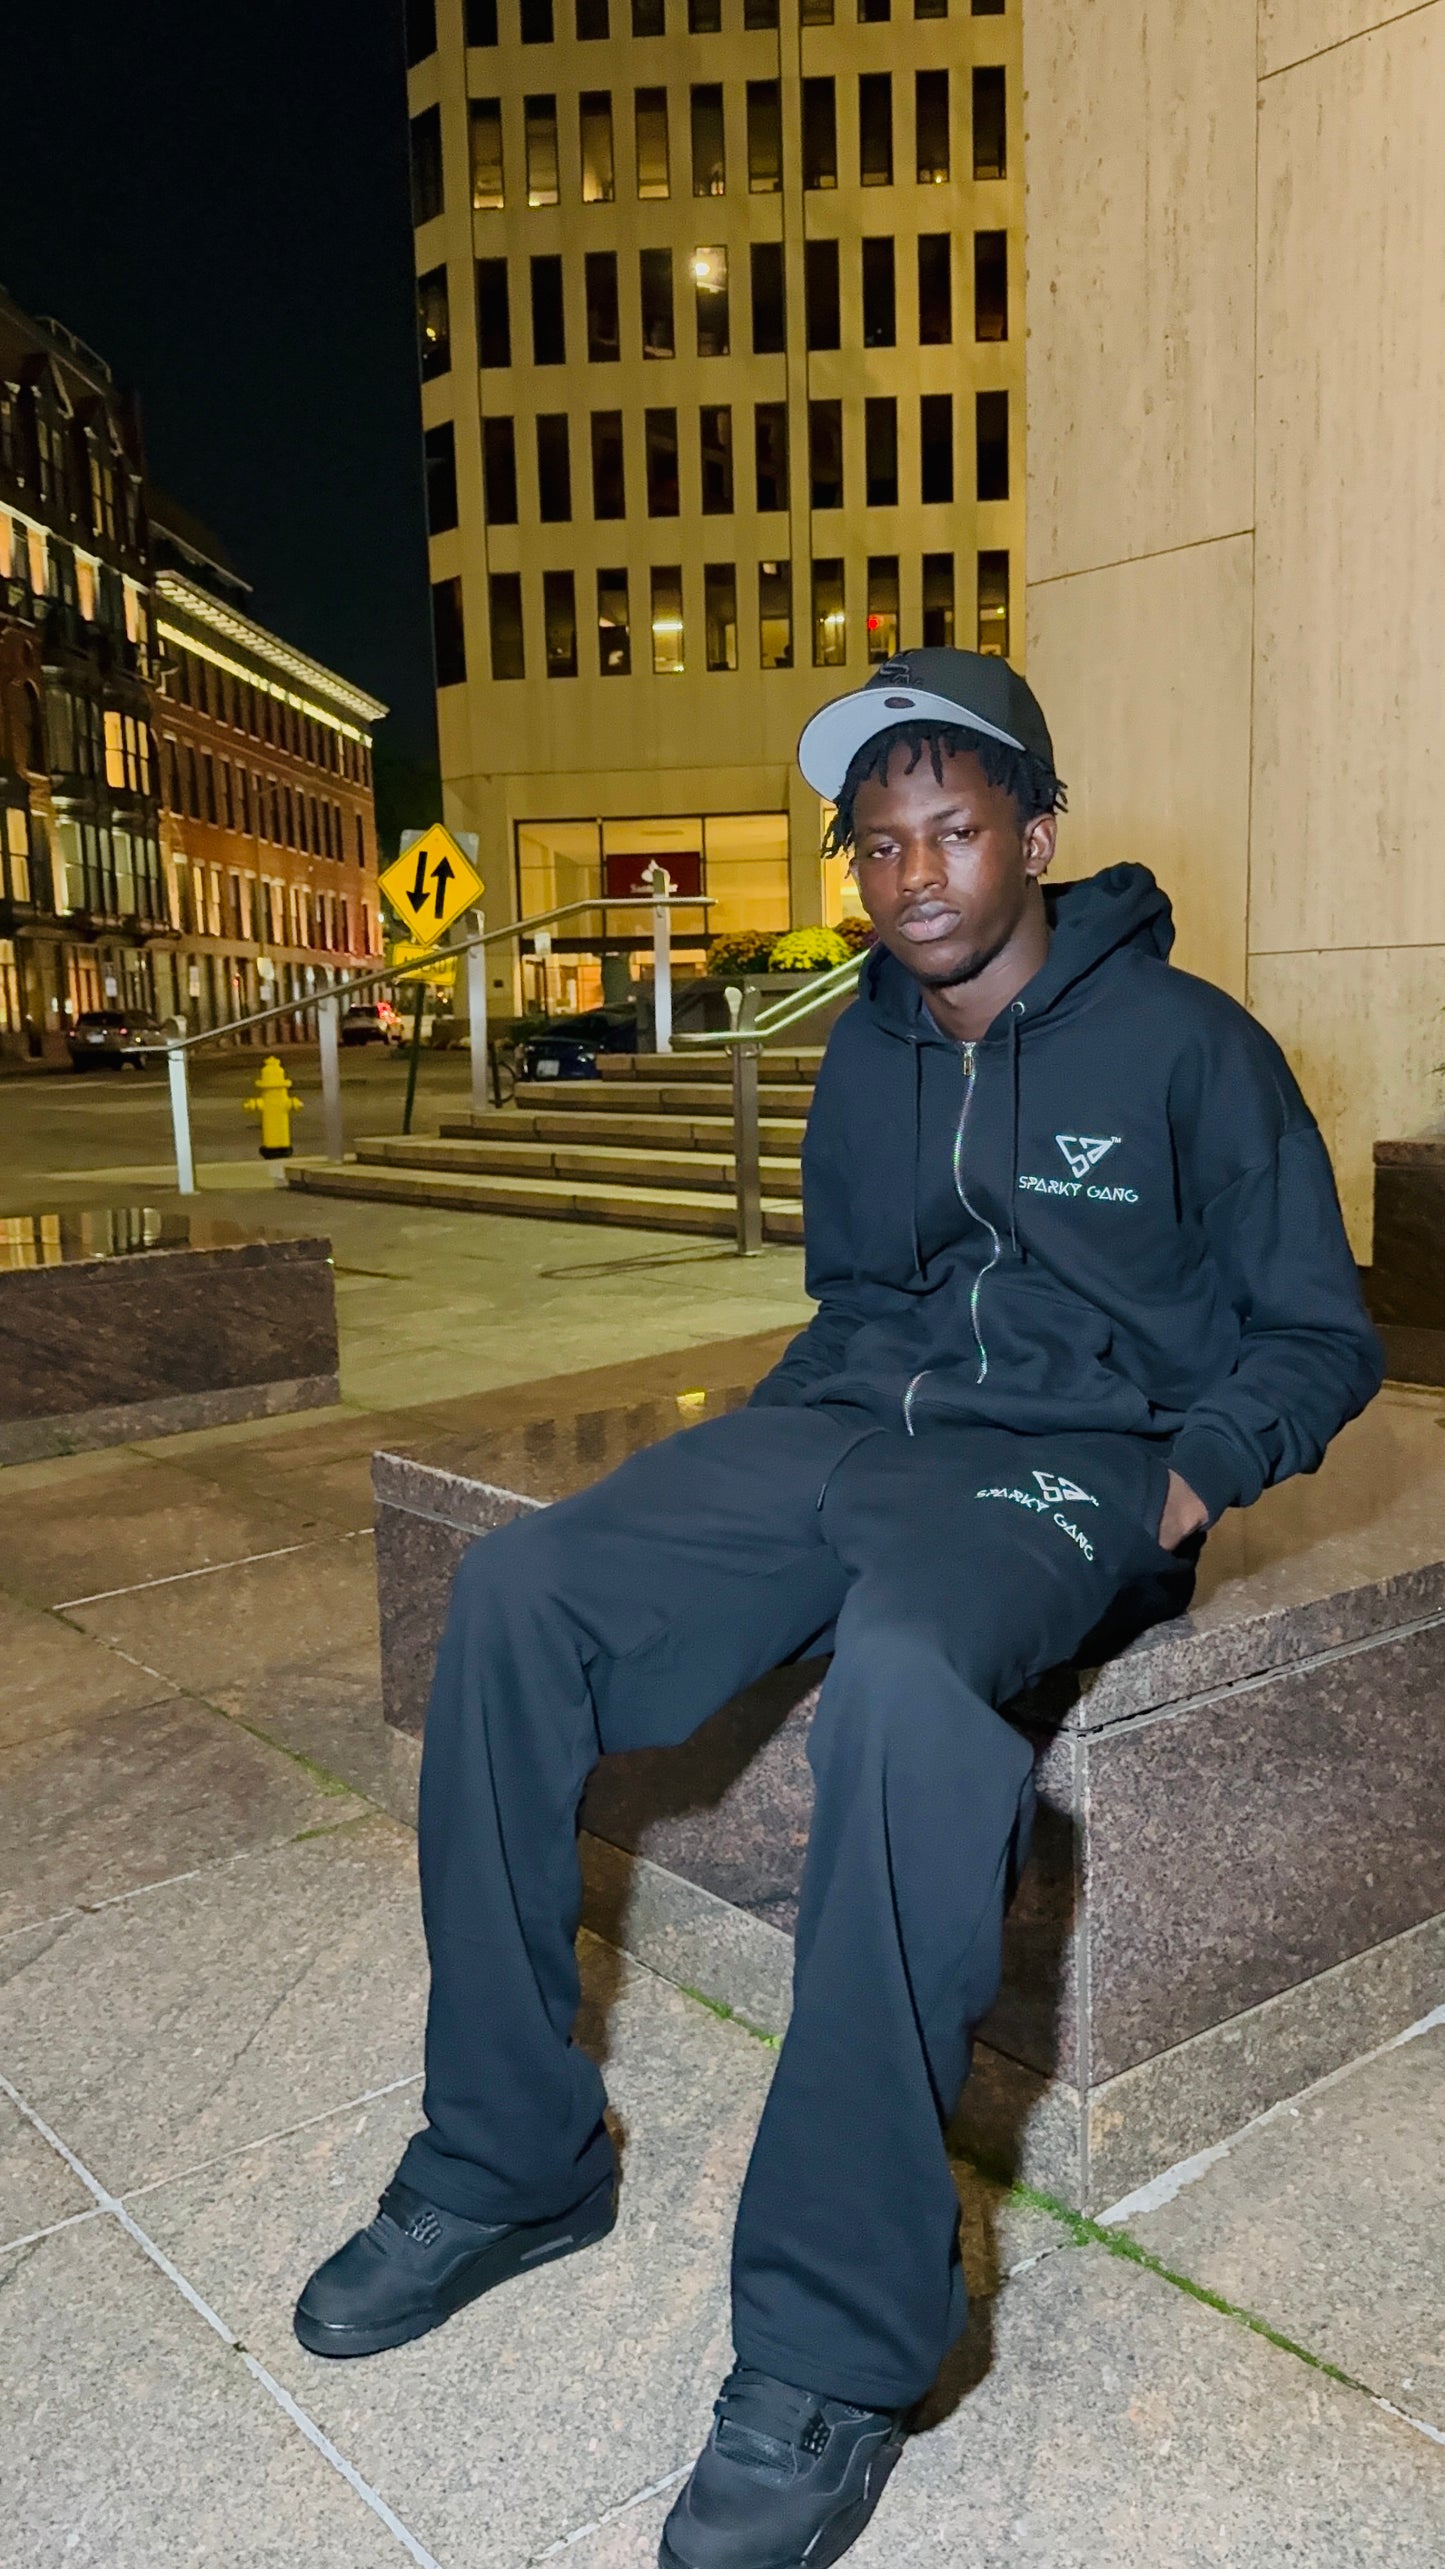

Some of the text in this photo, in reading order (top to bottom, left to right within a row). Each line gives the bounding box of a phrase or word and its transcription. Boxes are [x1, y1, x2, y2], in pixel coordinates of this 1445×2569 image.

[1018, 1176, 1139, 1203] SPARKY GANG
[974, 1487, 1094, 1561] SPARKY GANG
